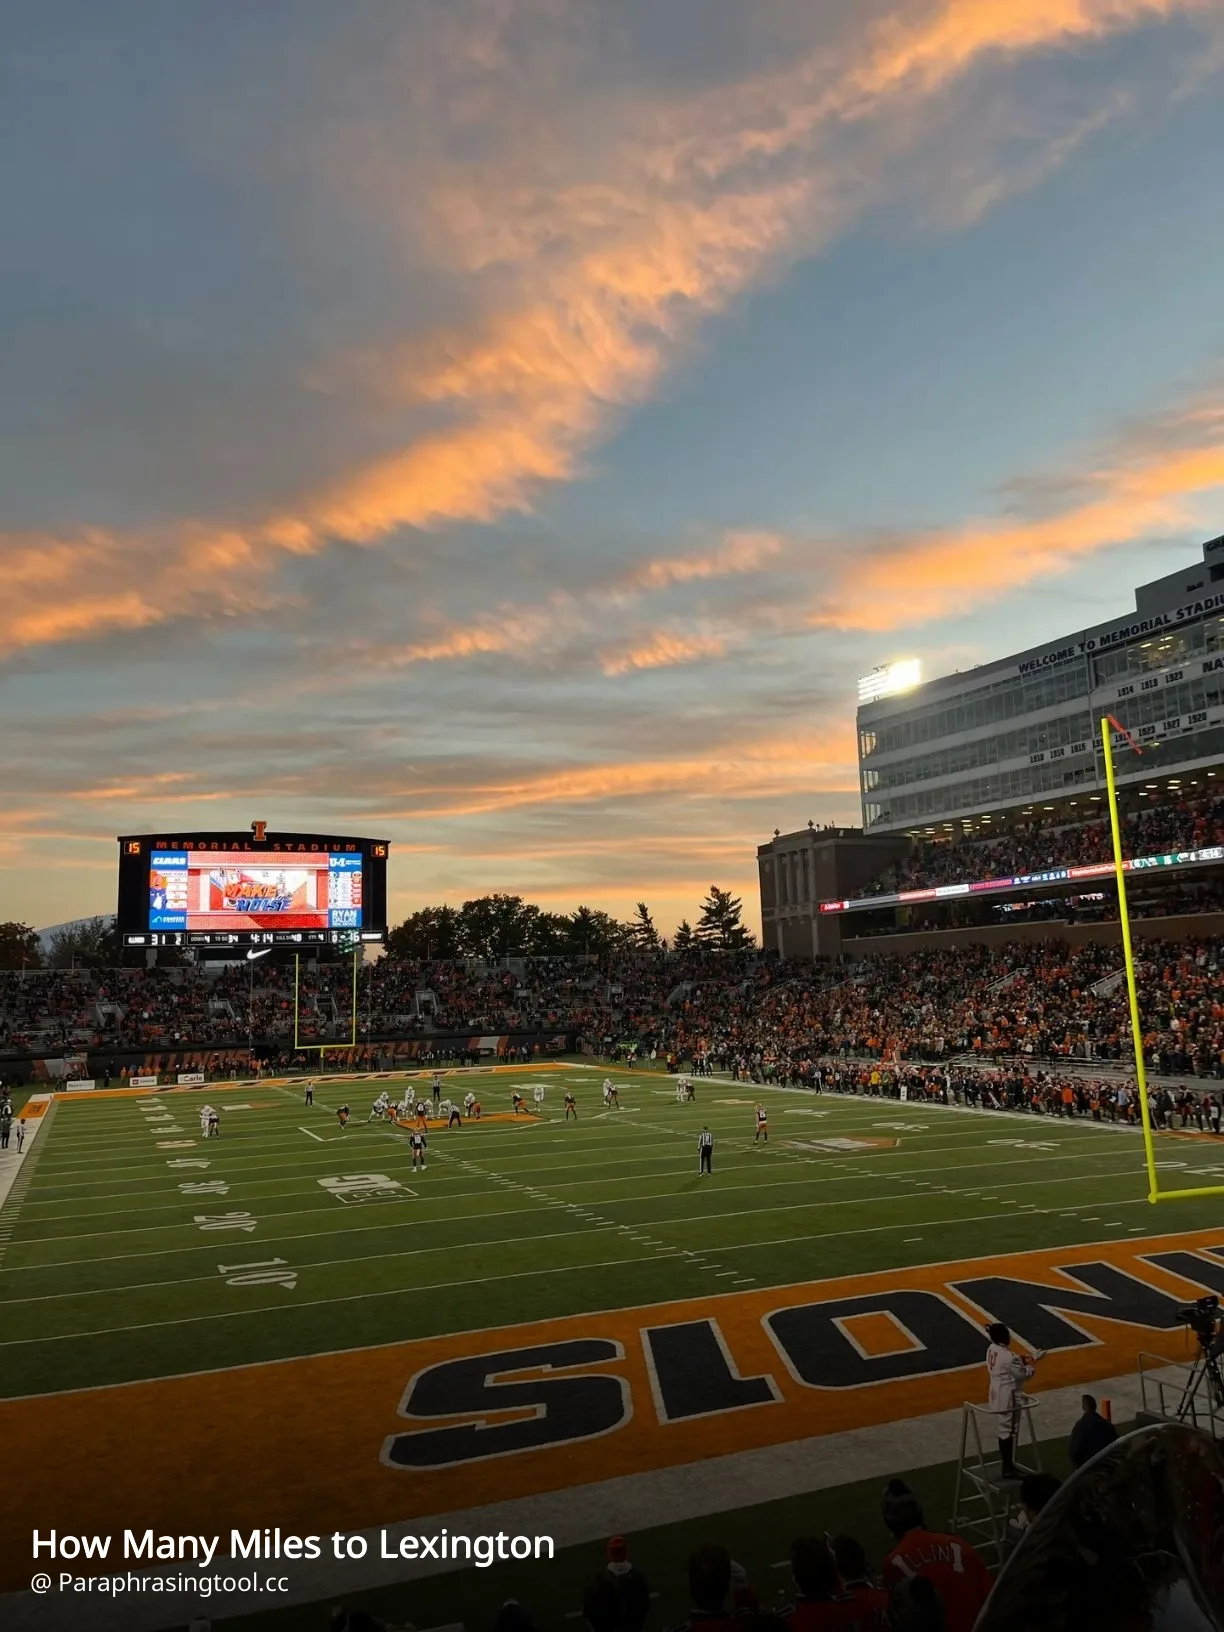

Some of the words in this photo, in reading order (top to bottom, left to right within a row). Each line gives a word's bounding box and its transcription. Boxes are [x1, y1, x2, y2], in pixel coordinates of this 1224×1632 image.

[1018, 646, 1075, 674] WELCOME
[1078, 640, 1096, 652] TO
[1099, 613, 1172, 647] MEMORIAL
[1202, 656, 1224, 673] NA
[128, 842, 140, 854] 15
[155, 840, 252, 850] MEMORIAL
[273, 842, 356, 852] STADIUM
[374, 845, 385, 856] 15
[222, 883, 278, 898] MAKE
[235, 897, 293, 912] NOISE
[151, 934, 166, 946] 31
[204, 935, 210, 943] 4
[228, 934, 239, 943] 34
[250, 933, 274, 943] 4:14
[193, 1211, 258, 1231] 20
[217, 1257, 298, 1287] 10
